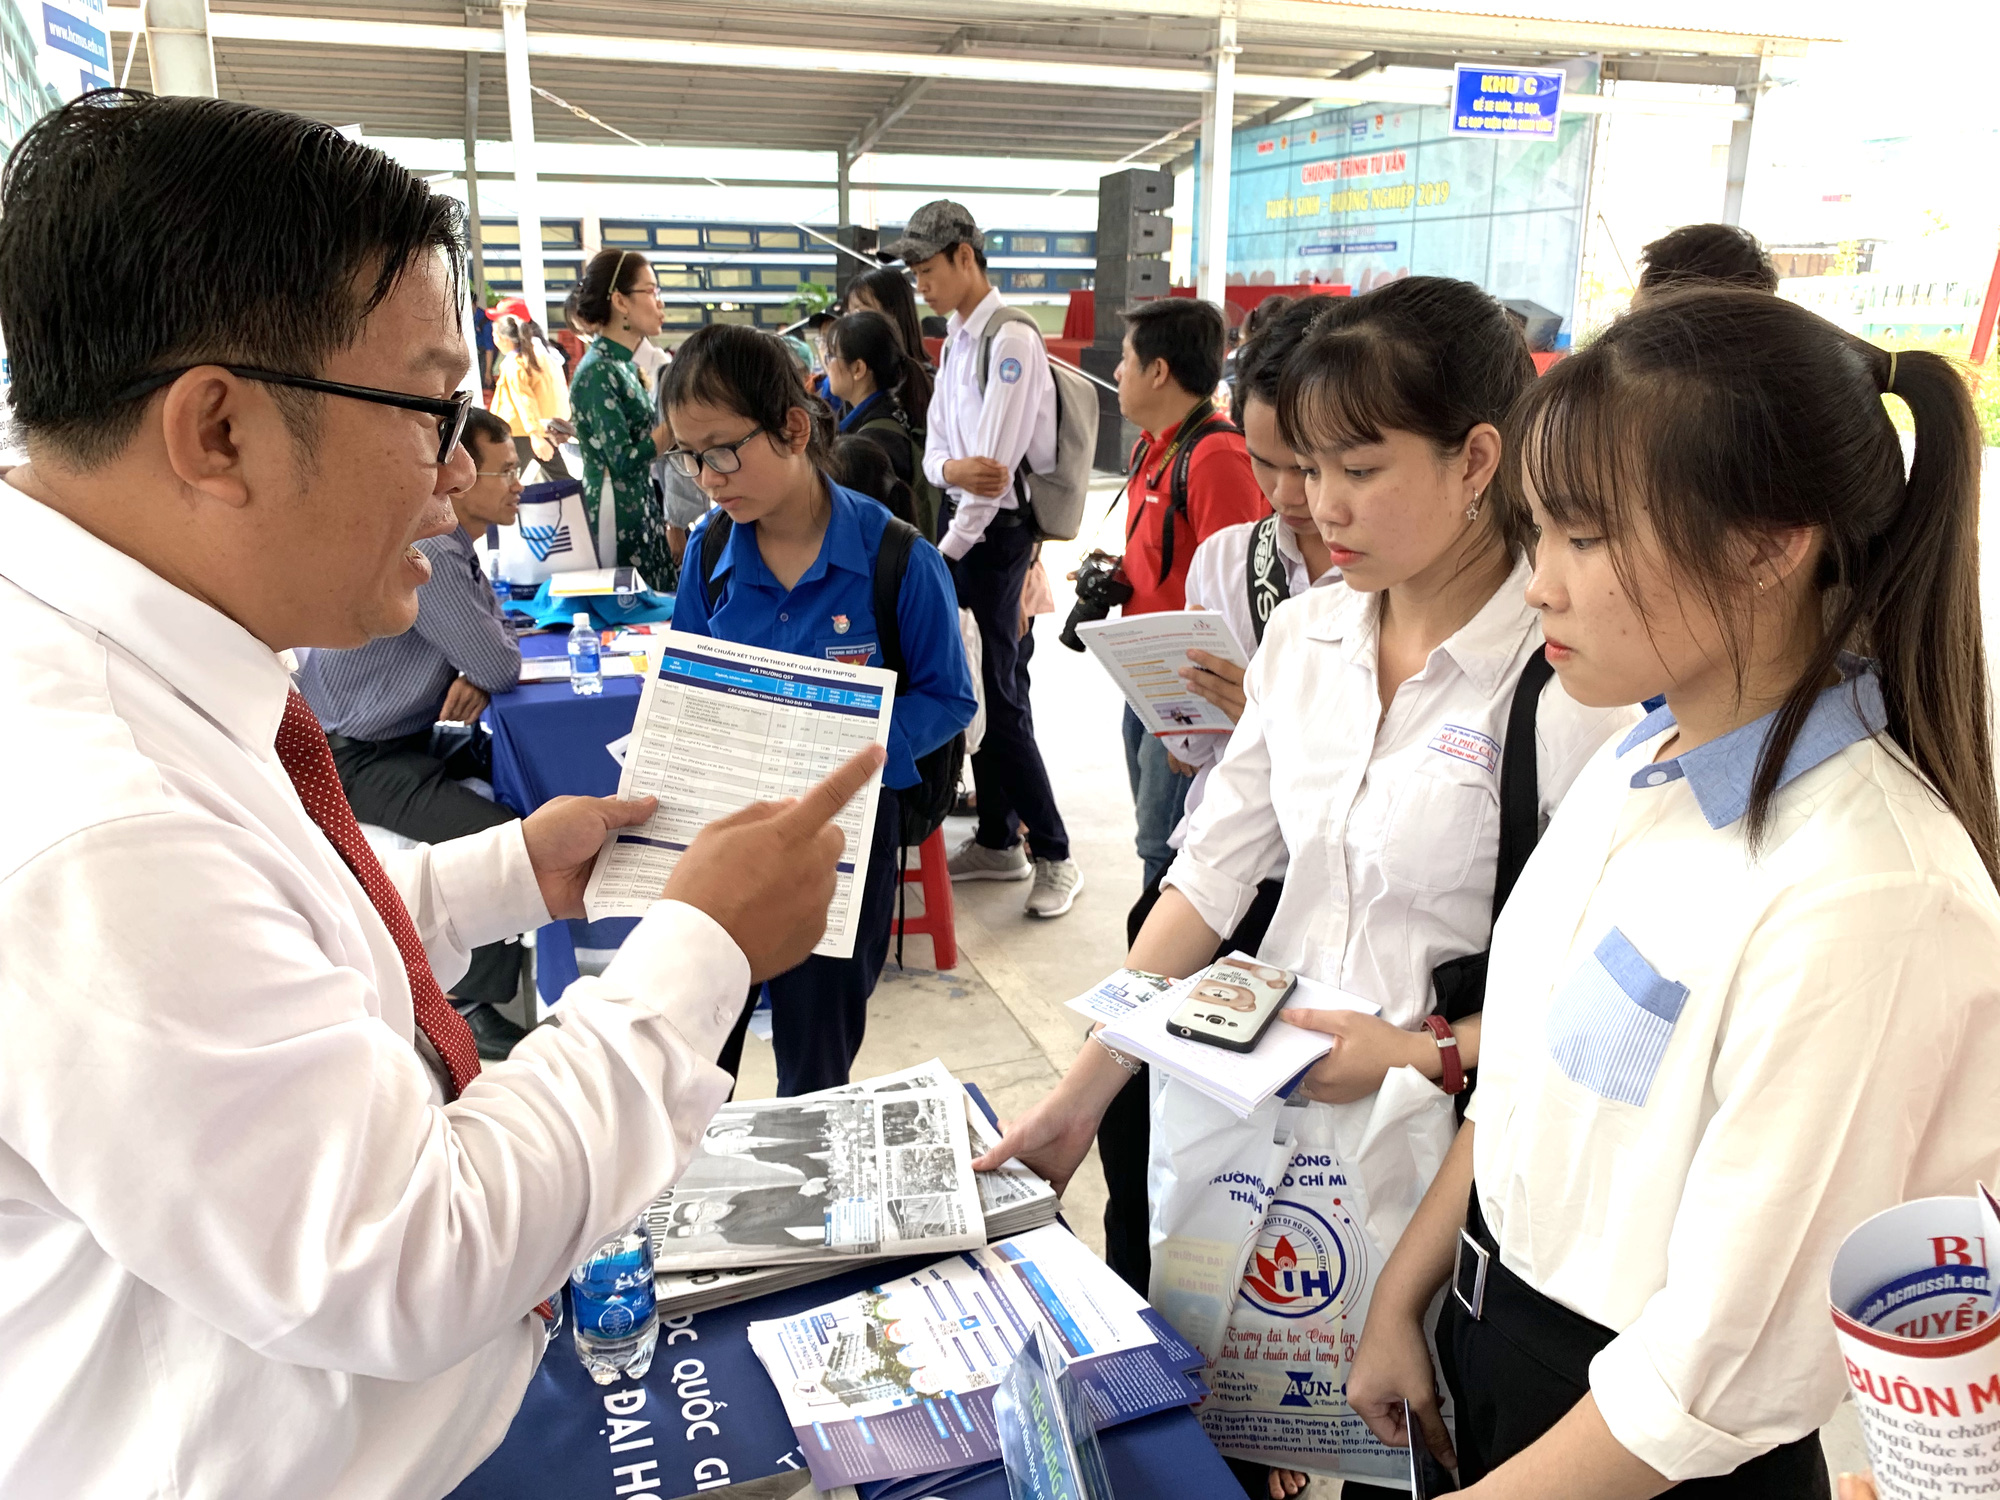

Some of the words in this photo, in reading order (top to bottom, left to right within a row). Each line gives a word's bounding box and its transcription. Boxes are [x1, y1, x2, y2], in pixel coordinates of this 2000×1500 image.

[1480, 75, 1520, 94] KHU
[1524, 77, 1538, 95] C
[1302, 161, 1338, 184] CHƯƠNG
[1340, 154, 1368, 179] TRÌNH
[1296, 195, 1320, 216] SINH
[1330, 188, 1368, 214] HƯỚNG
[1371, 180, 1415, 214] NGHIỆP
[1417, 181, 1450, 206] 2019
[696, 643, 713, 652] ĐIỂM
[713, 646, 736, 656] CHUẨN
[748, 653, 769, 663] TUYỂN
[798, 663, 812, 671] QUẢ
[832, 669, 856, 679] THPTQG
[759, 668, 782, 678] TRƯỜNG
[738, 688, 758, 698] CHƯƠNG
[758, 692, 773, 700] TRÌNH
[1299, 1172, 1324, 1186] CHÍ
[1226, 1326, 1262, 1347] Trường
[1266, 1328, 1282, 1343] đại
[1287, 1329, 1302, 1344] học
[1306, 1328, 1335, 1350] Công
[1244, 1346, 1258, 1362] đạt
[1292, 1346, 1311, 1362] chất
[670, 1358, 728, 1441] QUỐC
[1030, 1379, 1044, 1422] ThS
[1844, 1354, 1961, 1417] BUÔN
[599, 1388, 654, 1454] ĐẠI
[1010, 1372, 1019, 1415] Trường
[1018, 1414, 1026, 1430] ĐH
[1022, 1430, 1031, 1456] Khoa
[1028, 1453, 1036, 1479] học
[1340, 1420, 1363, 1428] Quận
[1866, 1405, 1898, 1428] nhu
[1904, 1420, 1941, 1438] cầu
[1878, 1427, 1912, 1450] ngũ
[1919, 1440, 1956, 1457] bác
[1963, 1443, 1987, 1458] sĩ,
[1888, 1447, 1968, 1476] Nguyên
[1886, 1463, 1941, 1492] thành
